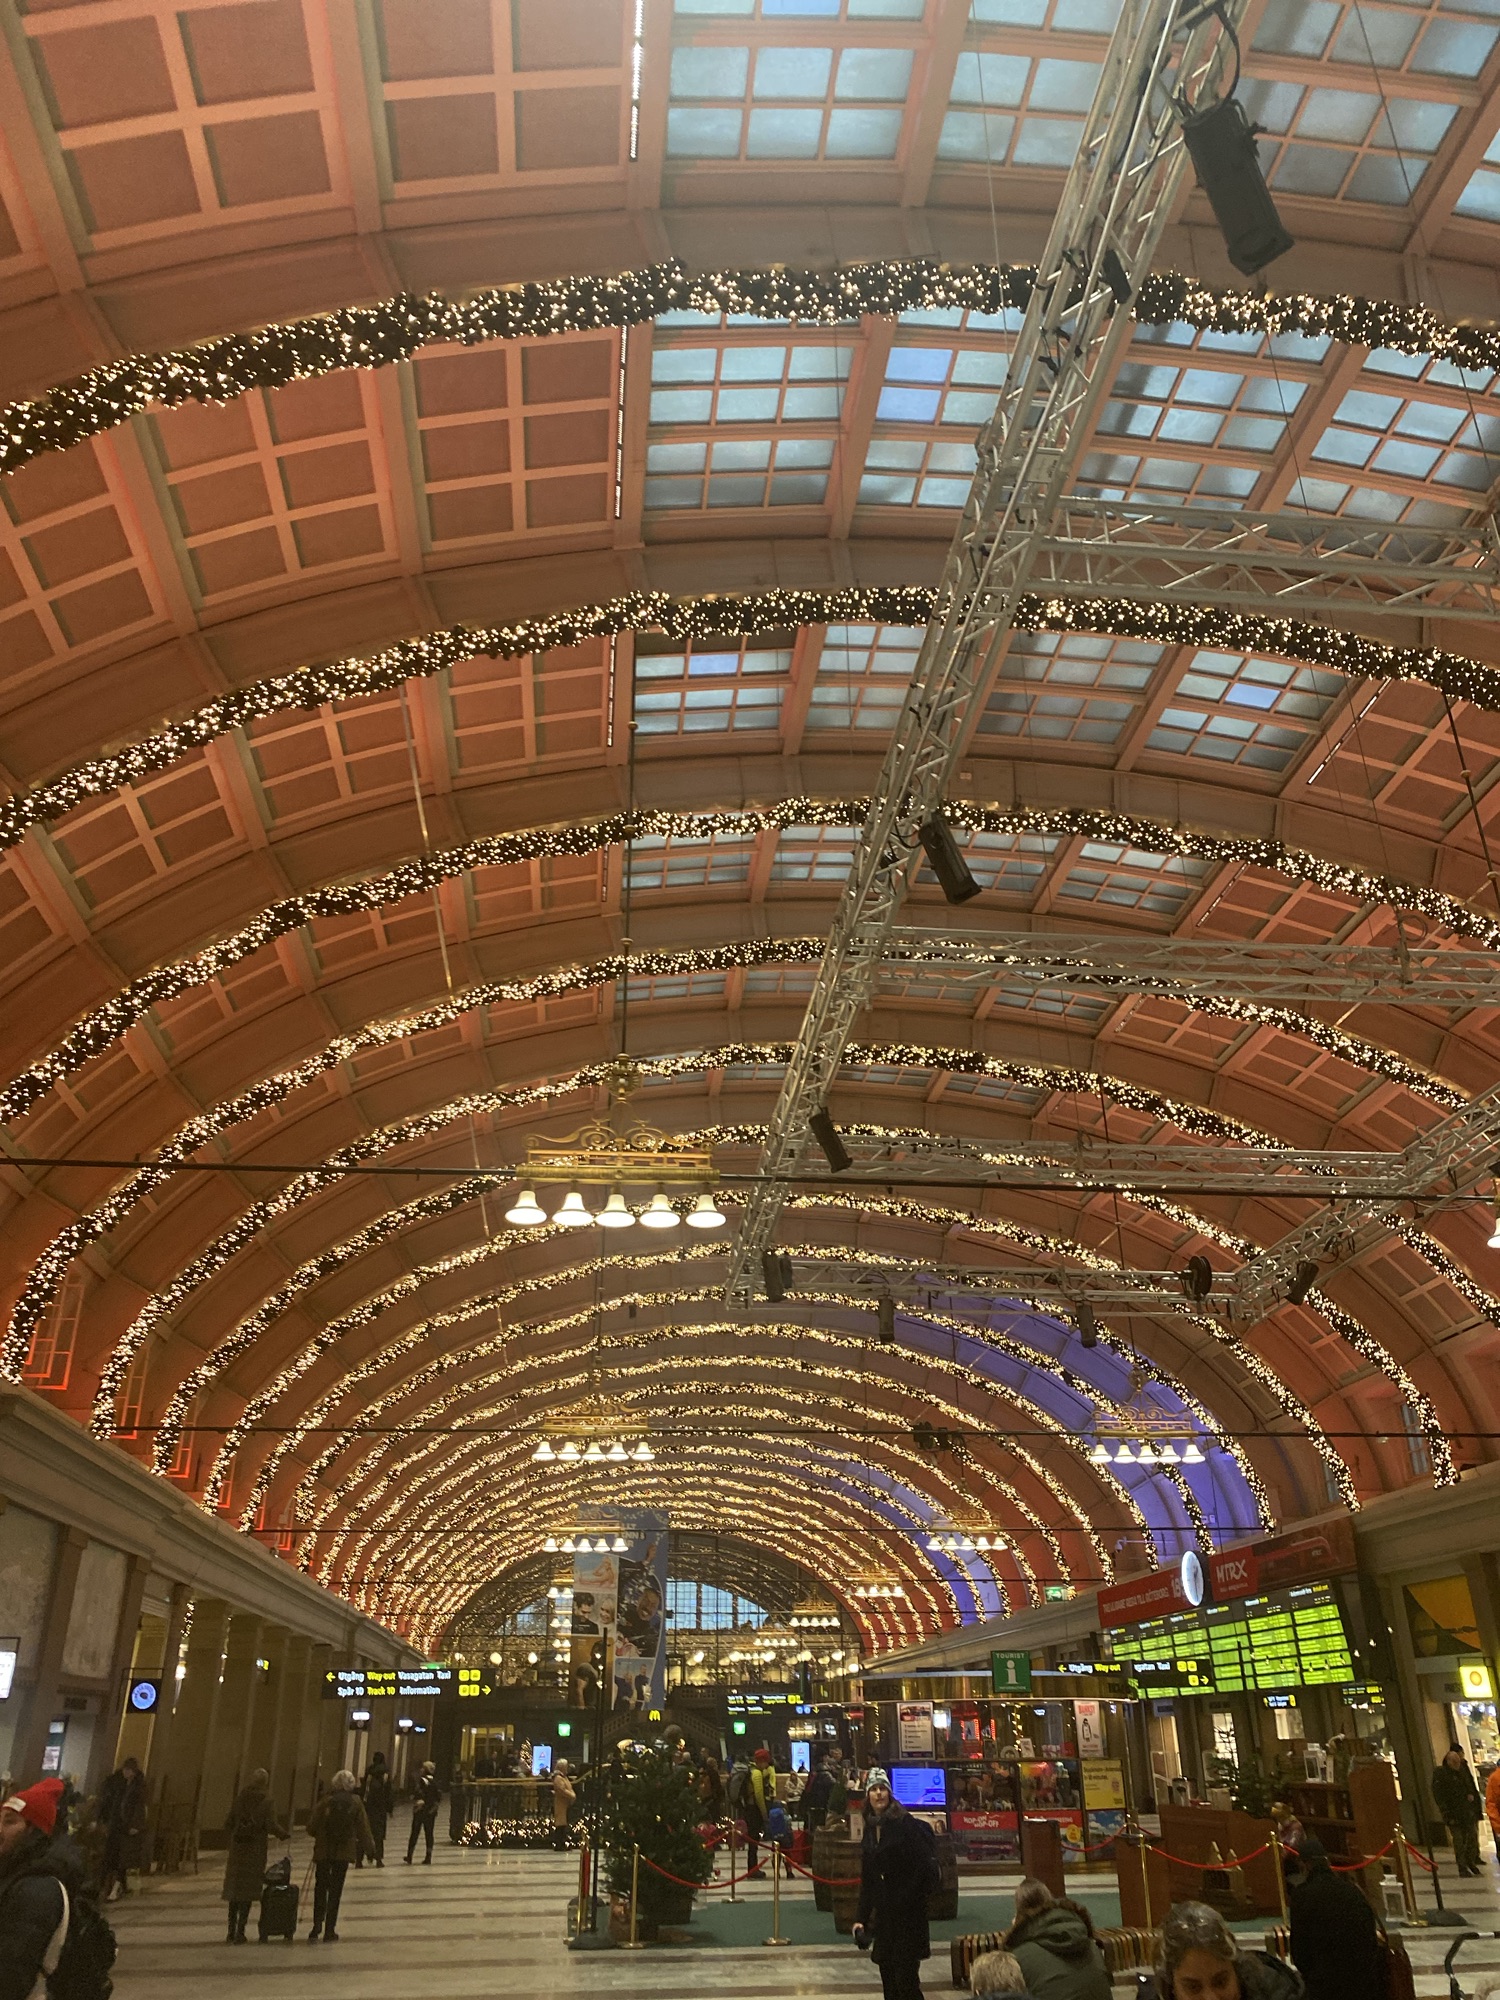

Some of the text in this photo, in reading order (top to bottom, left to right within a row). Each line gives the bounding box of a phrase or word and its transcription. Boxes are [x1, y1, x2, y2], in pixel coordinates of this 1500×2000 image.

[1216, 1559, 1247, 1583] MTRX
[995, 1652, 1025, 1660] TOURIST
[1094, 1663, 1109, 1673] Way
[1109, 1664, 1121, 1672] out
[338, 1671, 451, 1682] Utgång Way out Vasagatan Taxi
[338, 1686, 441, 1697] Spår 10 Track 10 Information
